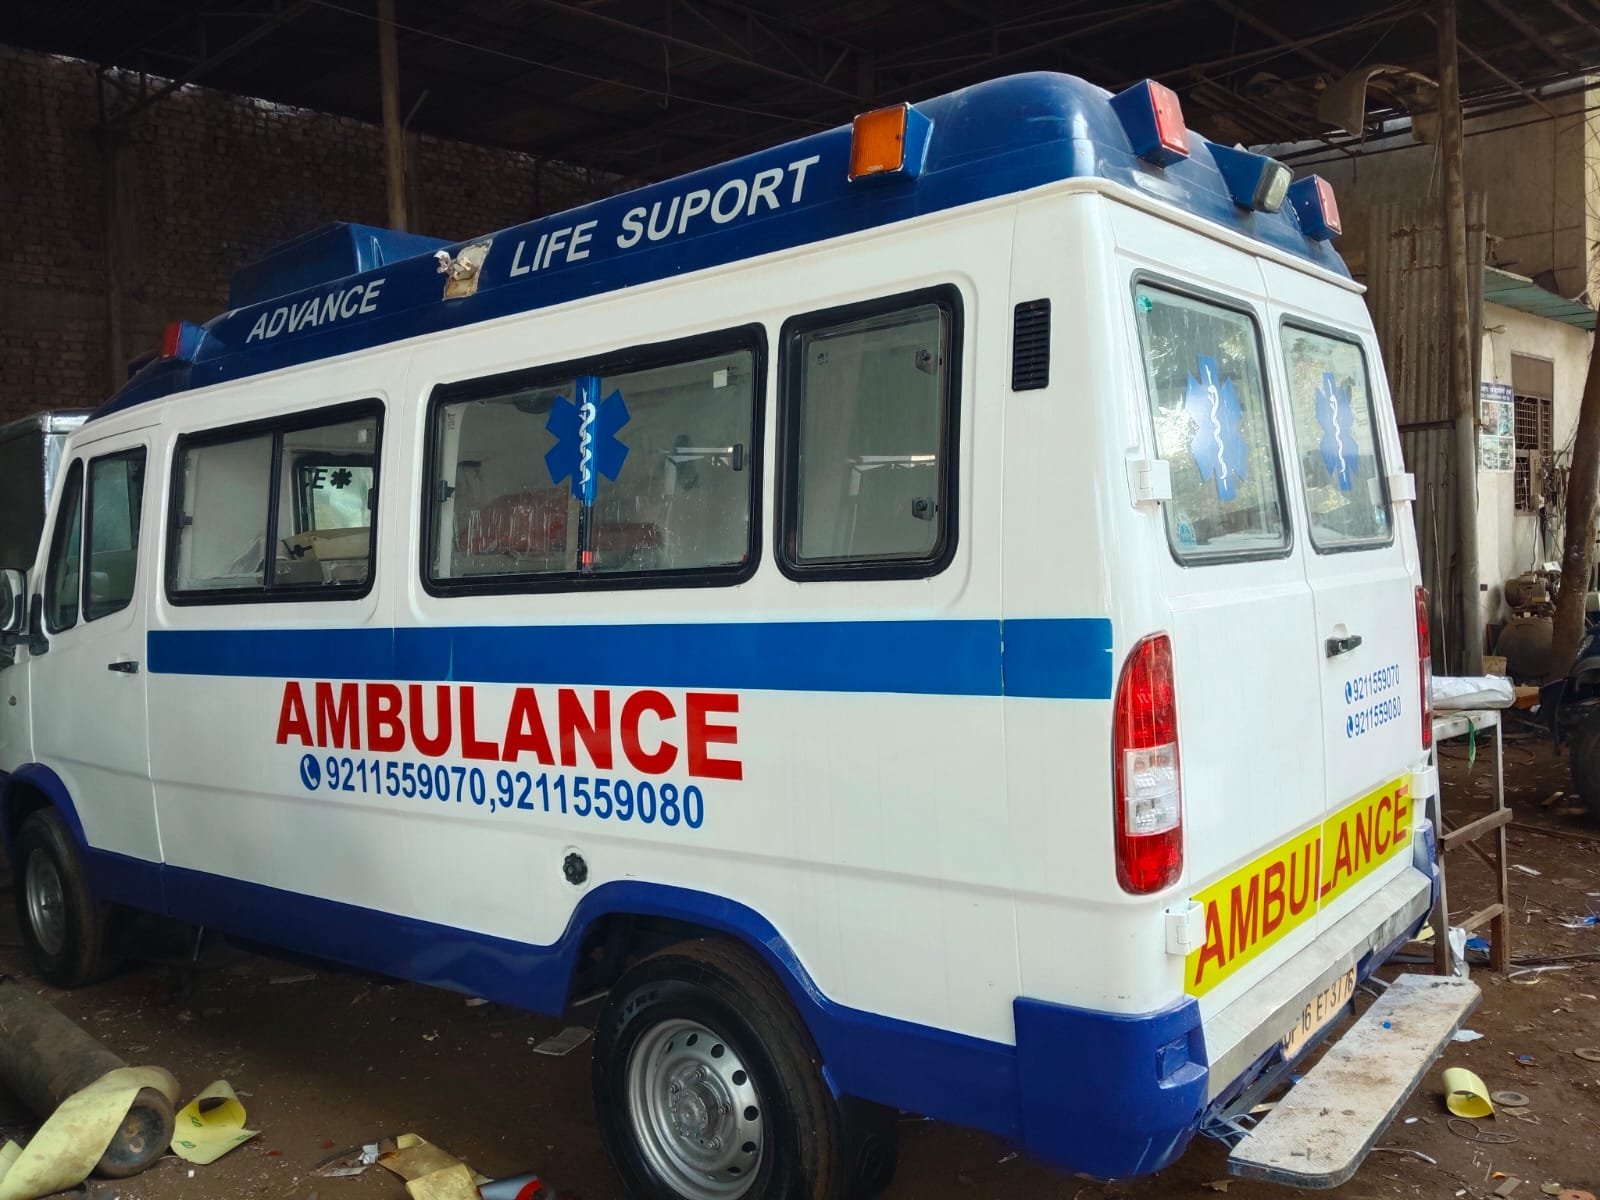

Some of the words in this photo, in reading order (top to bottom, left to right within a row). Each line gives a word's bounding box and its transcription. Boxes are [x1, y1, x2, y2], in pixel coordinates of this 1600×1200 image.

[246, 278, 386, 344] ADVANCE
[510, 219, 598, 278] LIFE
[616, 154, 821, 250] SUPORT
[1353, 663, 1400, 702] 9211559070
[1354, 695, 1402, 736] 9211559080
[275, 680, 744, 781] AMBULANCE
[1194, 783, 1409, 988] AMBULANCE
[1301, 1002, 1312, 1035] 16
